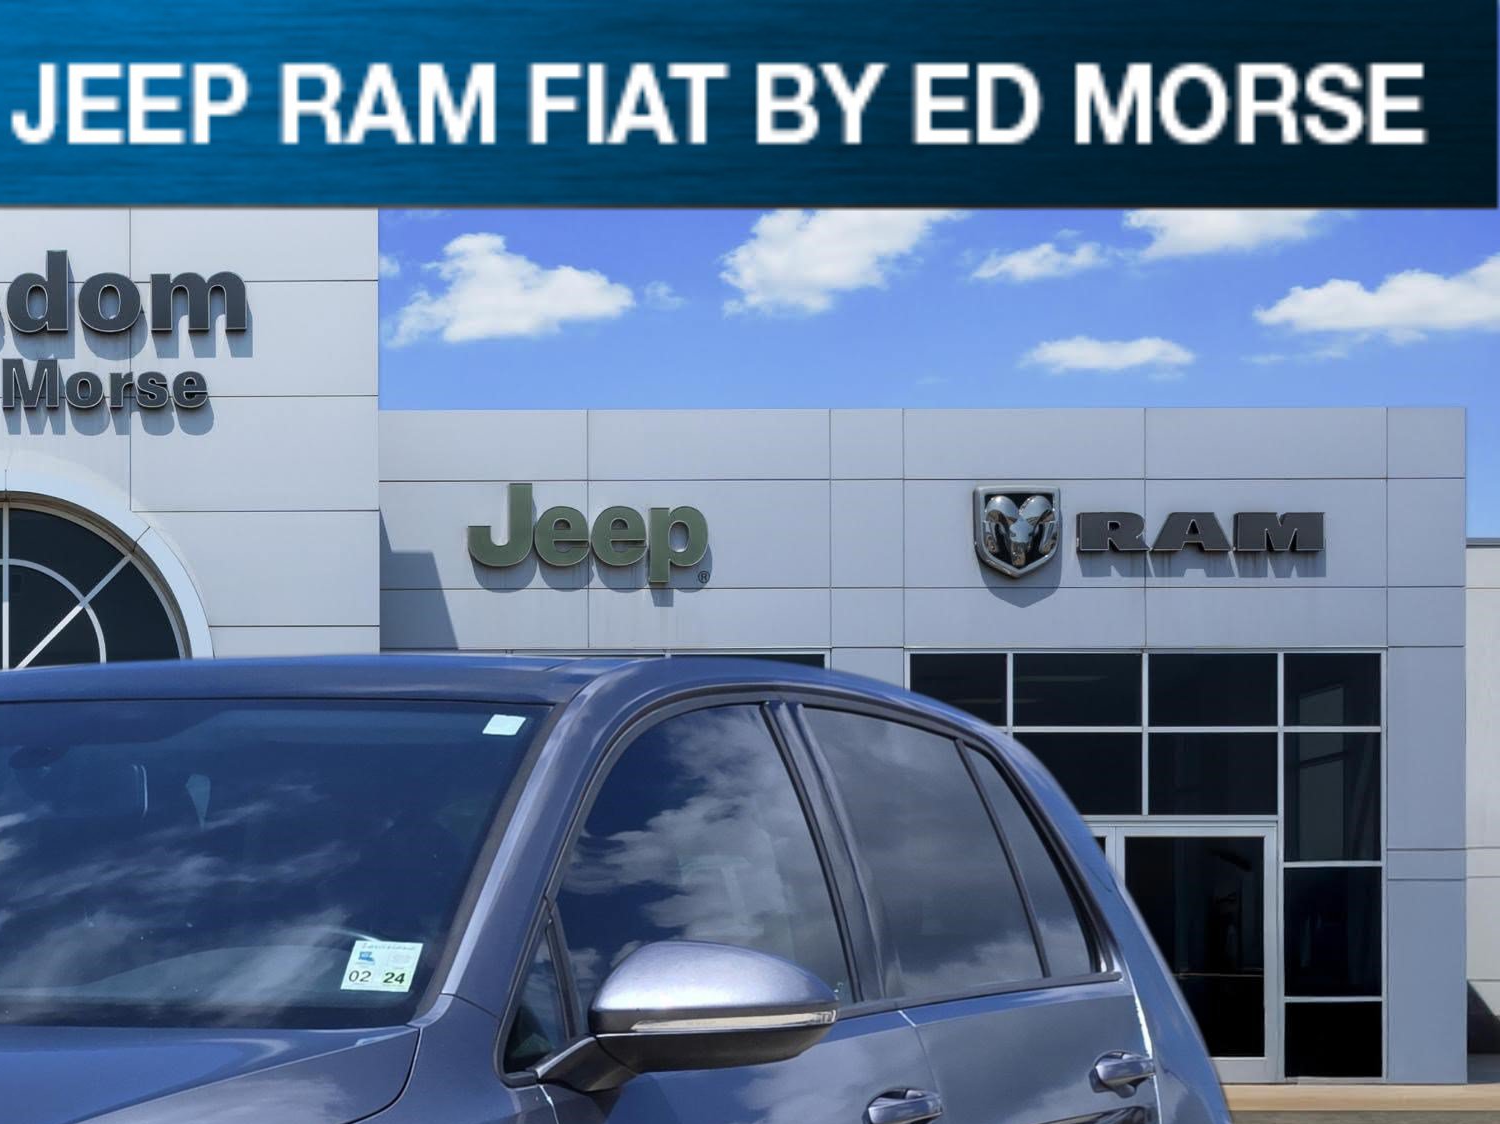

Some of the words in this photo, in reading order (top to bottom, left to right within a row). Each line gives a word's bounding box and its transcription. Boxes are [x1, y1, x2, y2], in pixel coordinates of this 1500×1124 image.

[1, 357, 210, 410] Morse
[467, 483, 709, 583] Jeep
[1076, 511, 1325, 552] RAM
[348, 970, 372, 983] 02
[383, 972, 406, 984] 24
